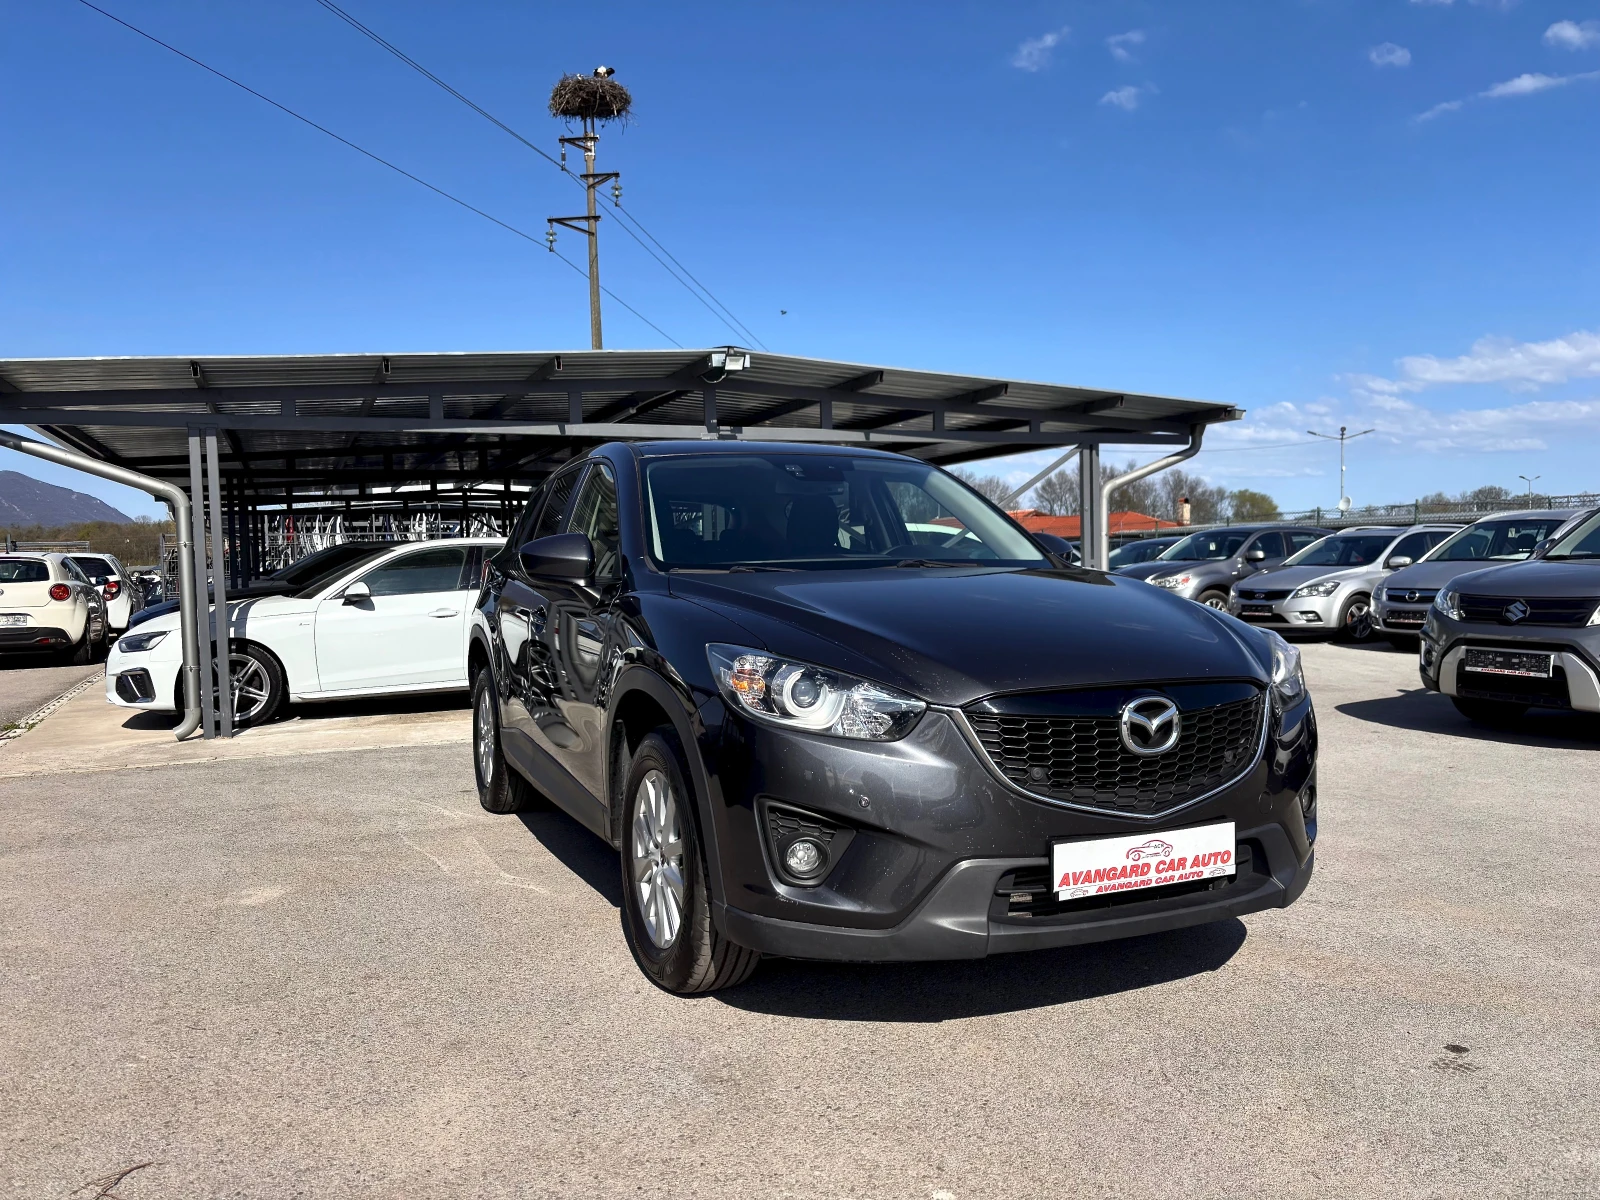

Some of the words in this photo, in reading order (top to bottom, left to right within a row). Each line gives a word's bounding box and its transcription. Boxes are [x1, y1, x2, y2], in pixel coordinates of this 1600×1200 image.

[1058, 863, 1151, 887] AVANGARD
[1154, 857, 1187, 874] CAR
[1190, 850, 1232, 869] AUTO
[1095, 879, 1152, 894] AVANGARD
[1154, 875, 1175, 885] CAR
[1176, 870, 1204, 881] AUTO
